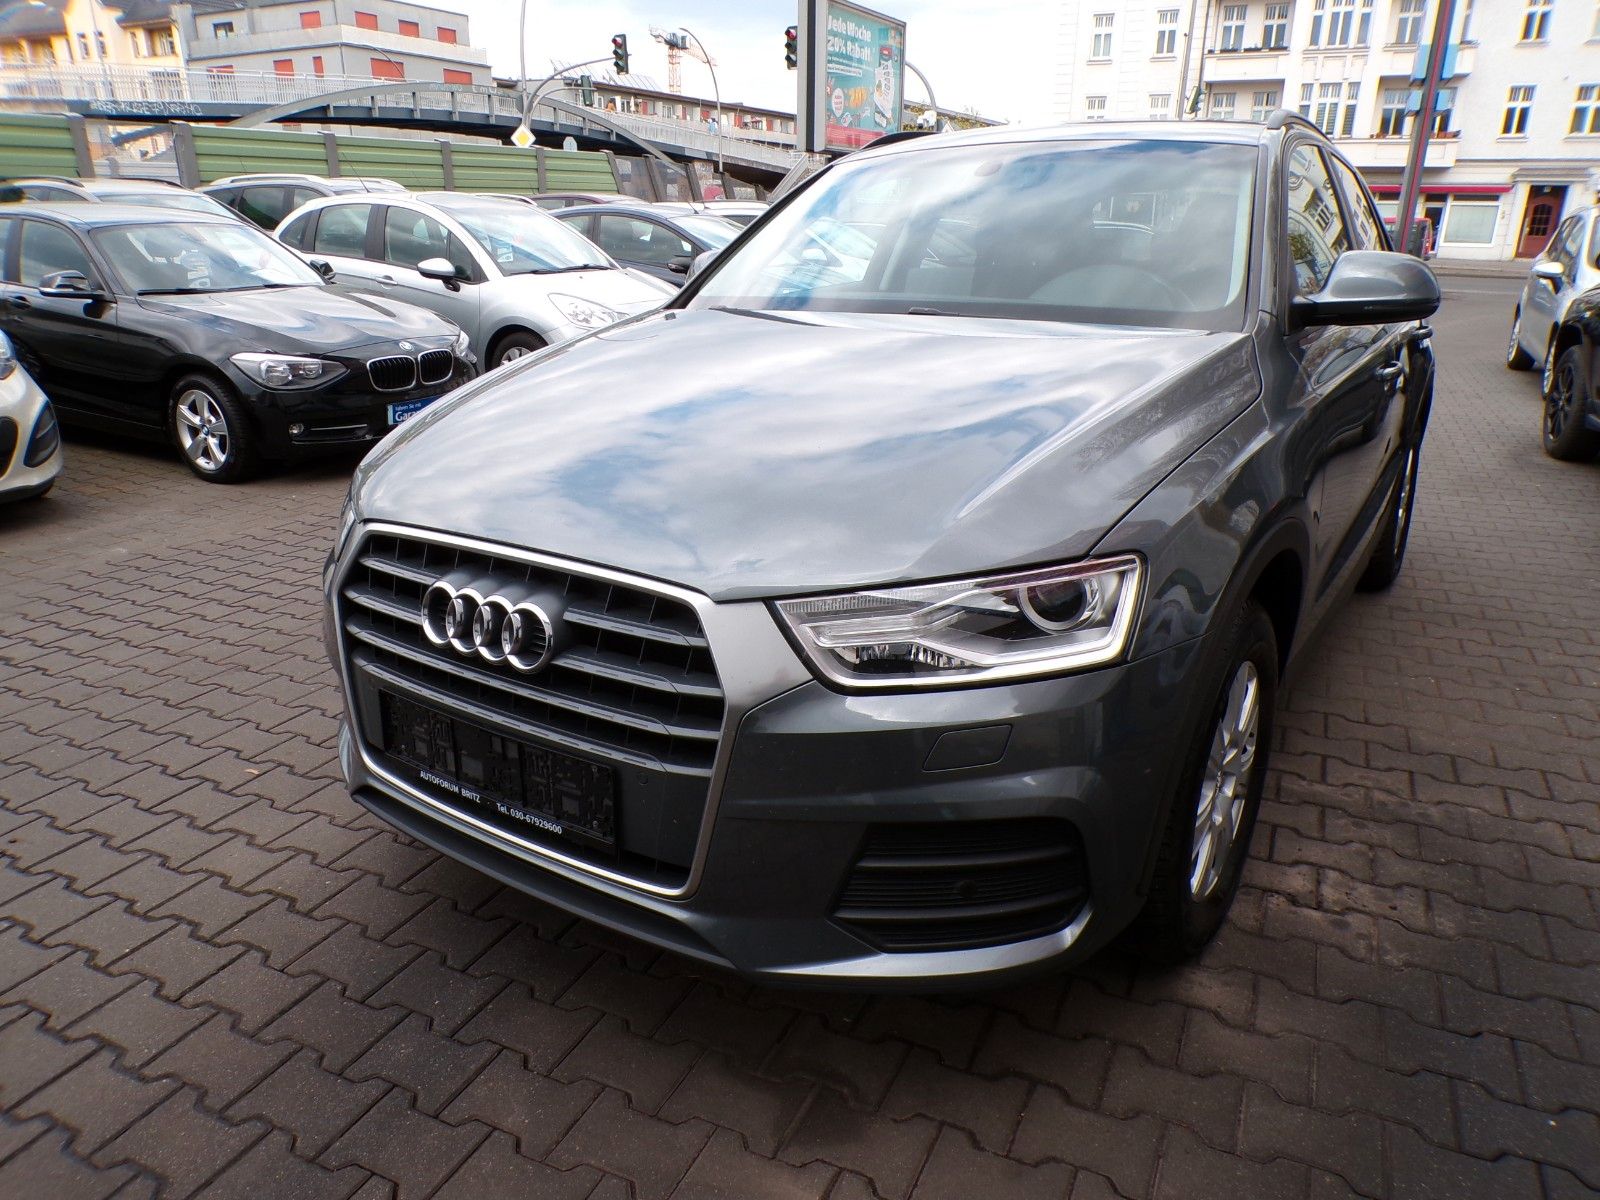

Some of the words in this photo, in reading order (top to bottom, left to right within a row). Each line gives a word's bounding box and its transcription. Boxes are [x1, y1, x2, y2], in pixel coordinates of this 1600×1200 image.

[827, 15, 847, 34] Jede
[847, 21, 871, 42] Woche
[826, 36, 846, 54] 20%
[847, 41, 871, 61] Rabatt
[420, 770, 459, 794] AUTOFORUM
[461, 788, 481, 803] BRITZ
[510, 809, 562, 835] 030-67929600
